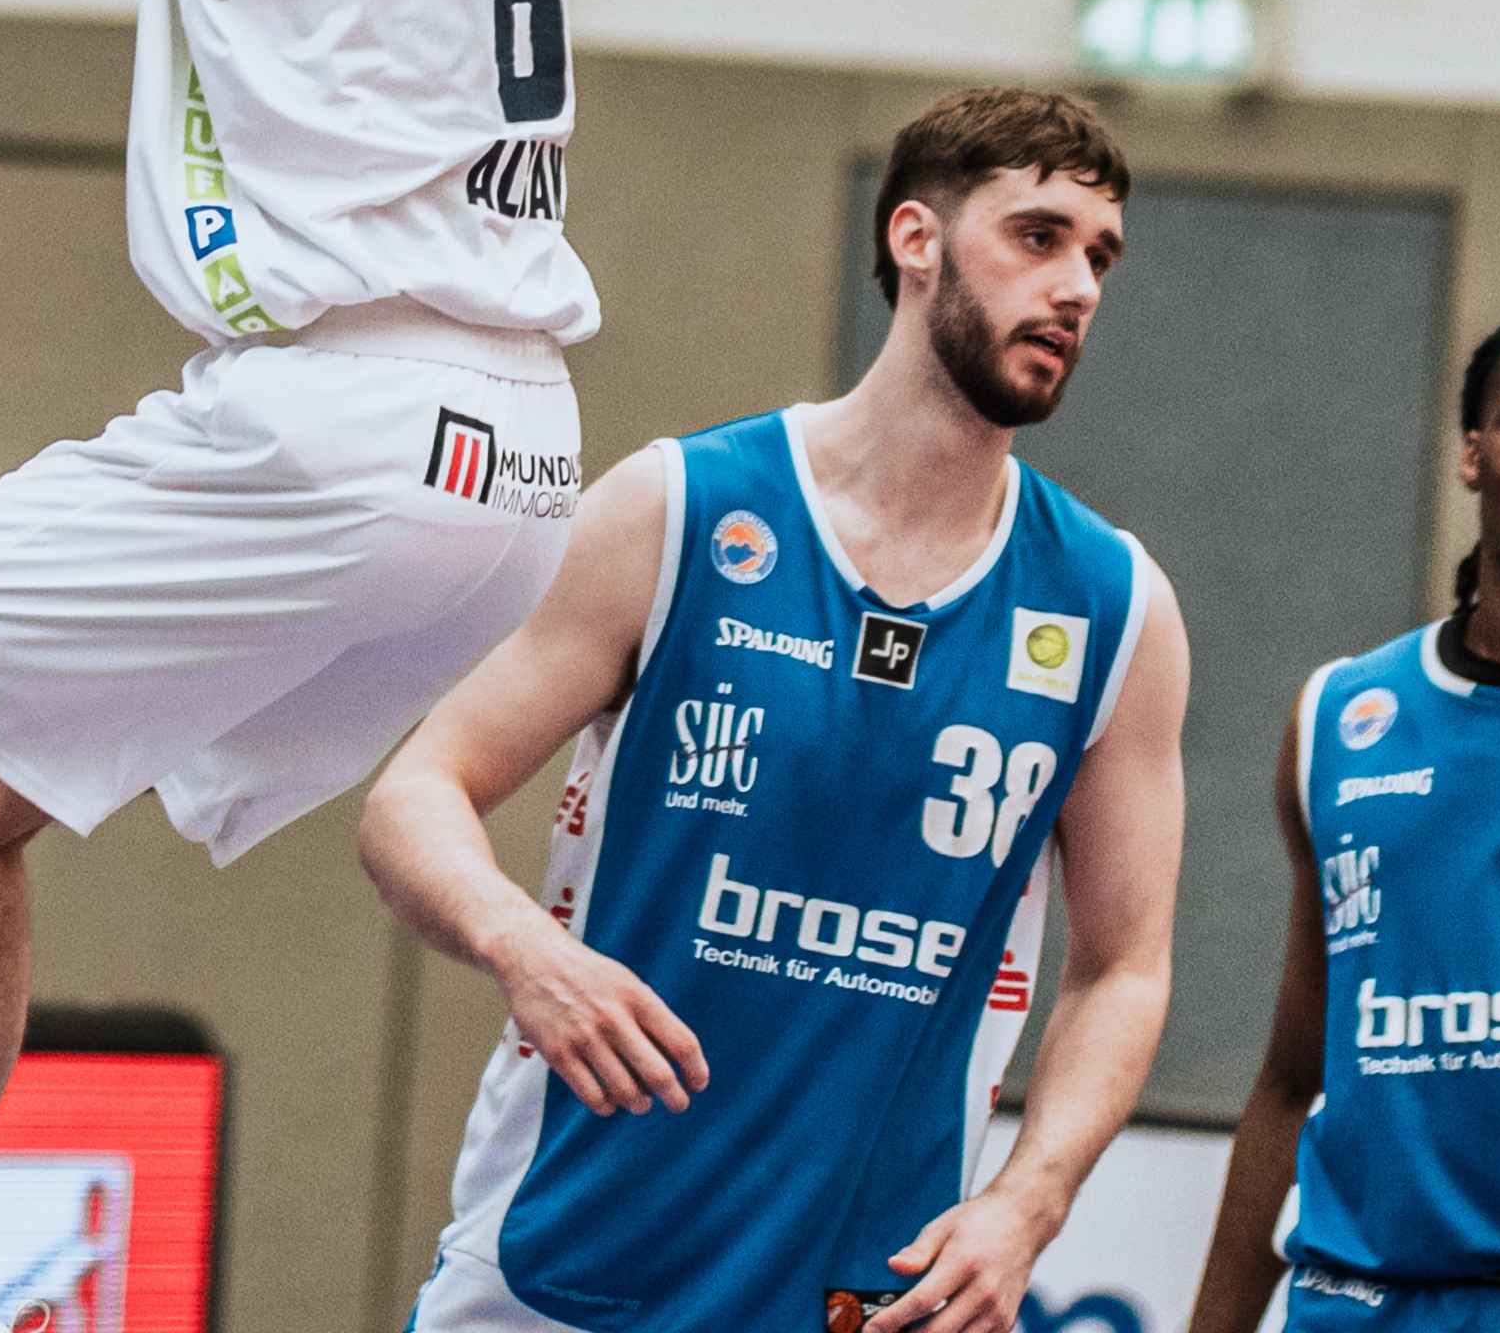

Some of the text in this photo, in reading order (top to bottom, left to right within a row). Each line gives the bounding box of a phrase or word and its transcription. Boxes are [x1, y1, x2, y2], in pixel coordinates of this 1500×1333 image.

[715, 616, 835, 670] SPALDING
[668, 682, 765, 793] SÜC
[664, 791, 699, 809] Und
[921, 724, 1058, 869] 38
[698, 852, 967, 978] brose
[693, 938, 780, 974] Technik
[785, 959, 820, 982] für
[1357, 1053, 1437, 1076] Technik
